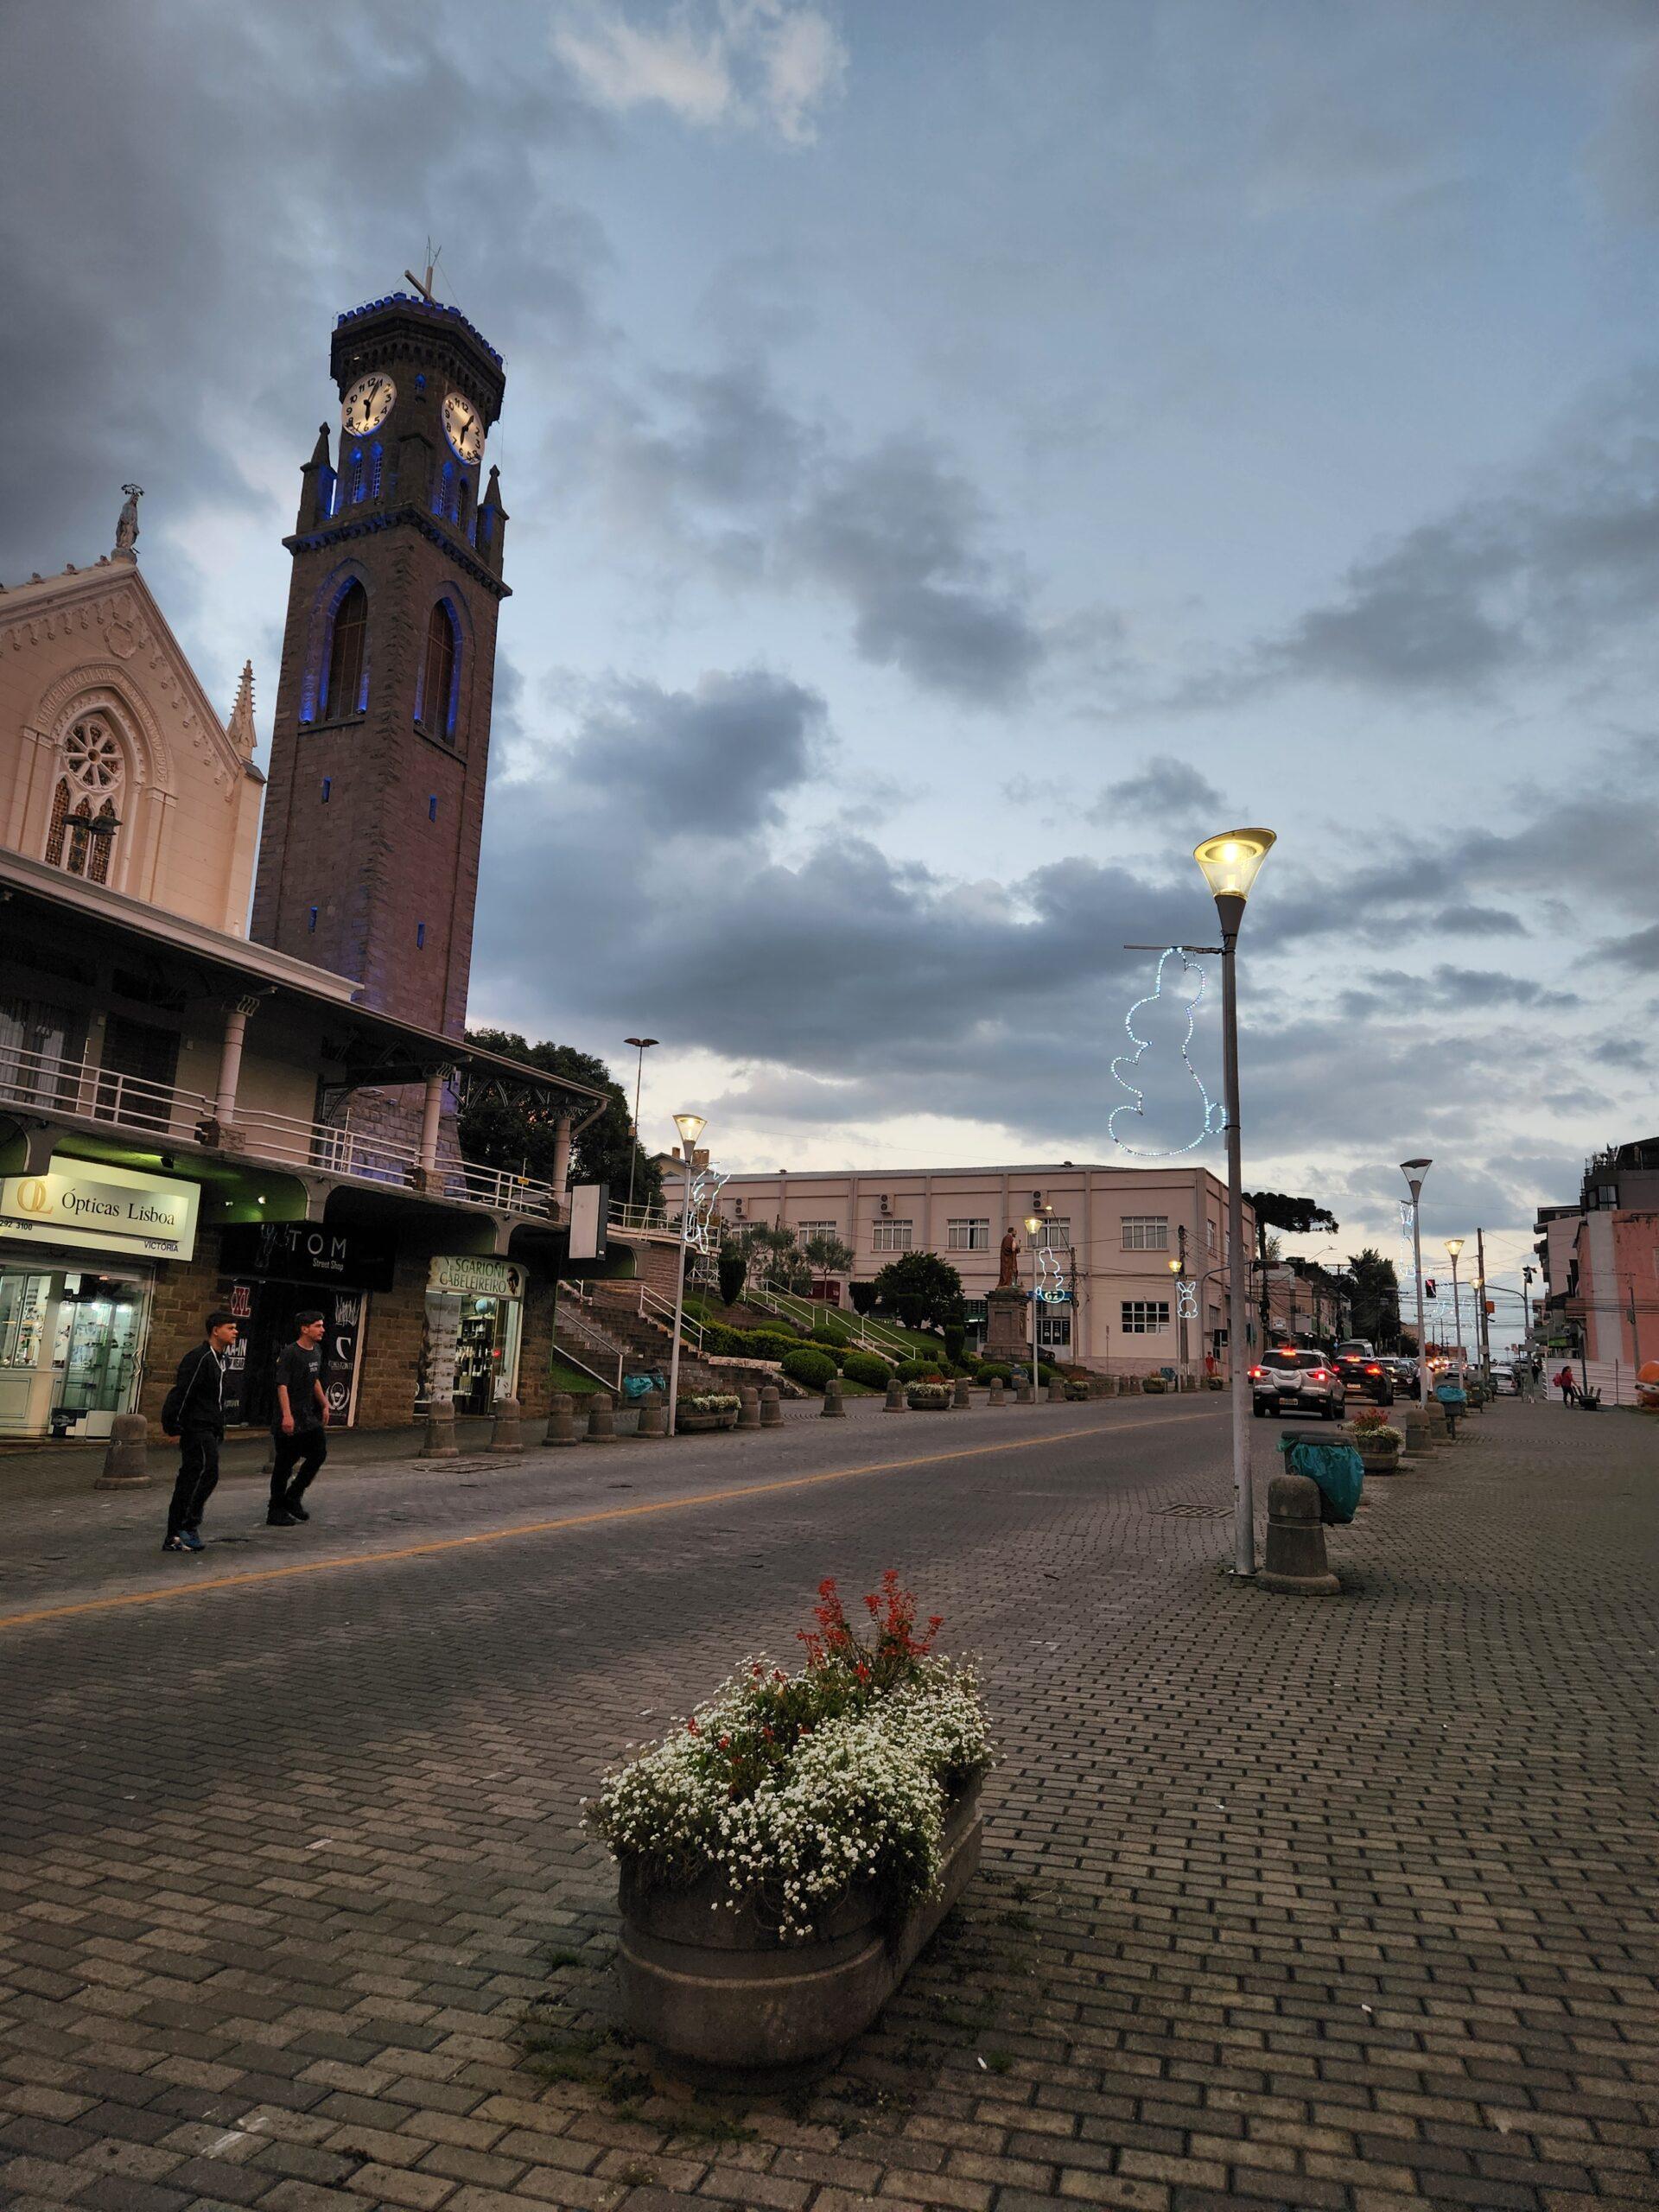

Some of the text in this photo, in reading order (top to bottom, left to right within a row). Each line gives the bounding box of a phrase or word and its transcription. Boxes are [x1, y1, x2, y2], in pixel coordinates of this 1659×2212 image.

[367, 378, 376, 387] 12
[359, 384, 365, 392] 11
[350, 394, 358, 404] 10
[385, 393, 391, 404] 3
[454, 397, 461, 408] 11
[346, 406, 353, 415] 9
[380, 406, 387, 415] 4
[461, 402, 468, 413] 12
[444, 409, 450, 419] 9
[373, 416, 380, 426] 5
[356, 422, 361, 431] 7
[446, 422, 451, 433] 8
[474, 426, 480, 436] 2
[452, 435, 457, 445] 7
[474, 439, 480, 449] 3
[458, 447, 464, 456] 6
[61, 1188, 175, 1225] Ópticas Lisboa
[16, 1222, 33, 1231] 3100
[312, 1257, 344, 1272] Street Shop
[439, 1271, 507, 1294] CABELEIREIRO
